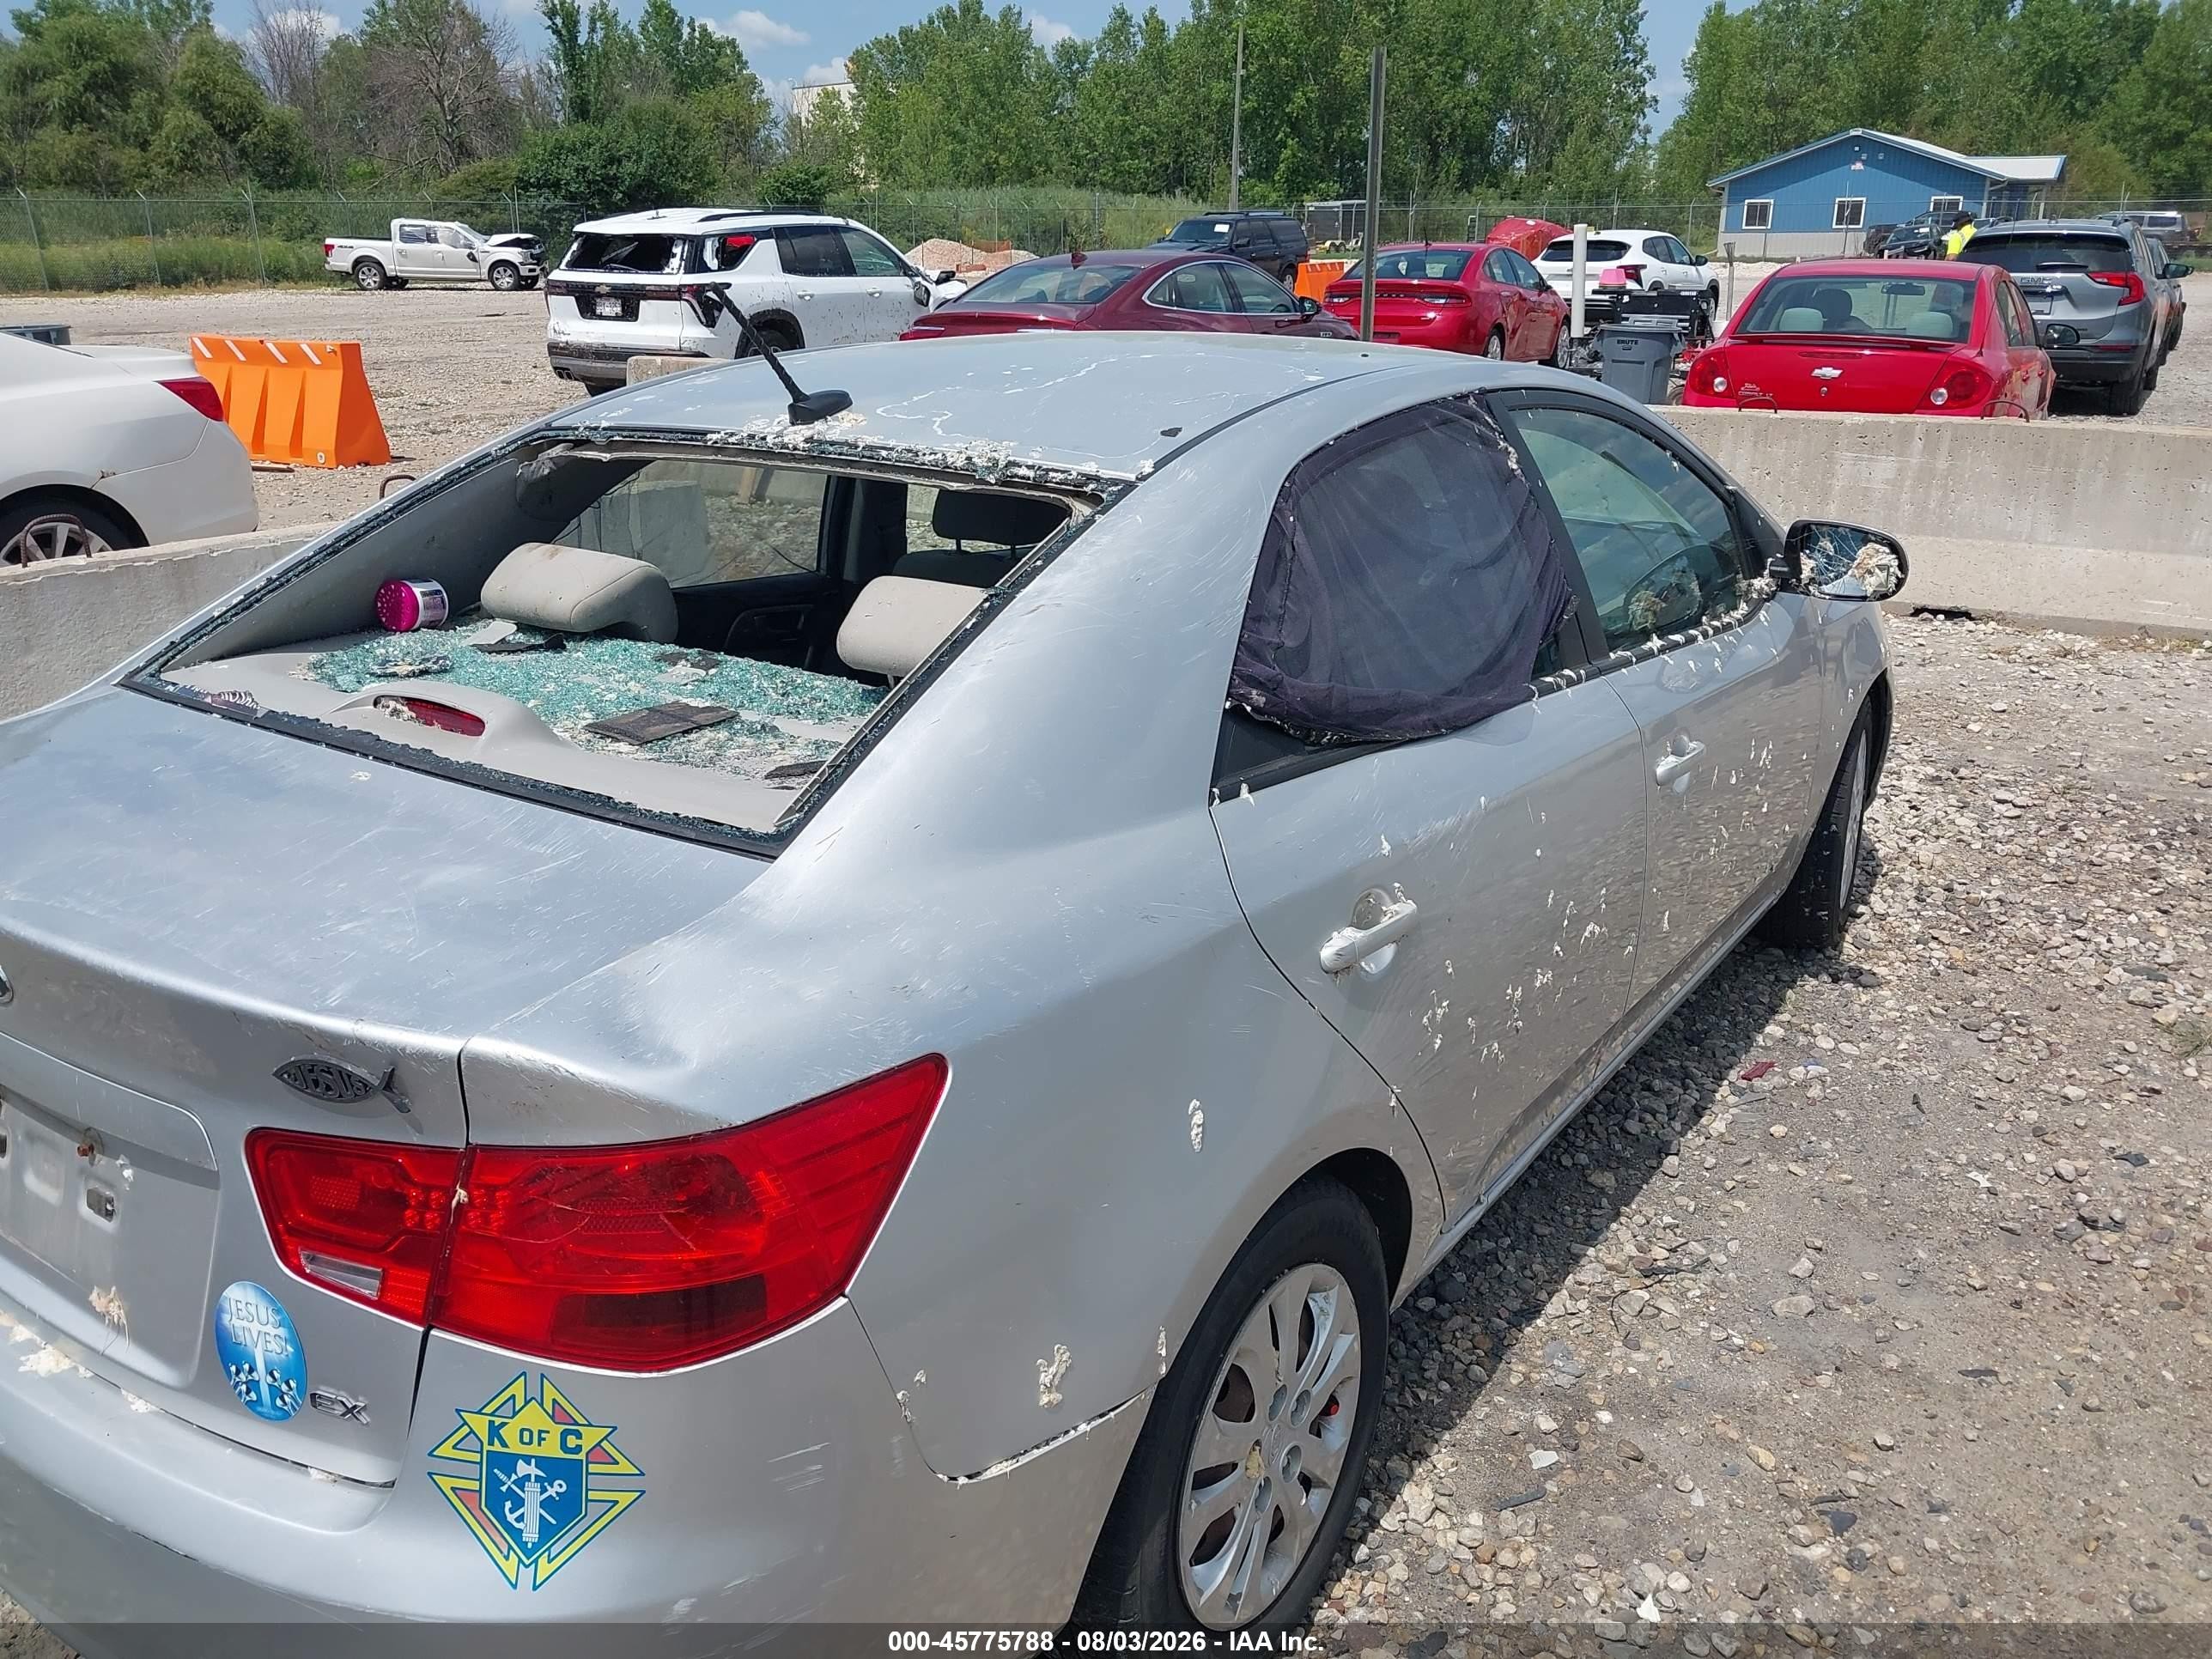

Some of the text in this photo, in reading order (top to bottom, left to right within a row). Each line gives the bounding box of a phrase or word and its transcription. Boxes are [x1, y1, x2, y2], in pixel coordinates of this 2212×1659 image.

[283, 1063, 371, 1099] JESUS
[228, 1297, 281, 1329] JESUS
[231, 1323, 289, 1357] LIVES!
[310, 1389, 370, 1425] EX
[488, 1419, 583, 1455] K OF C
